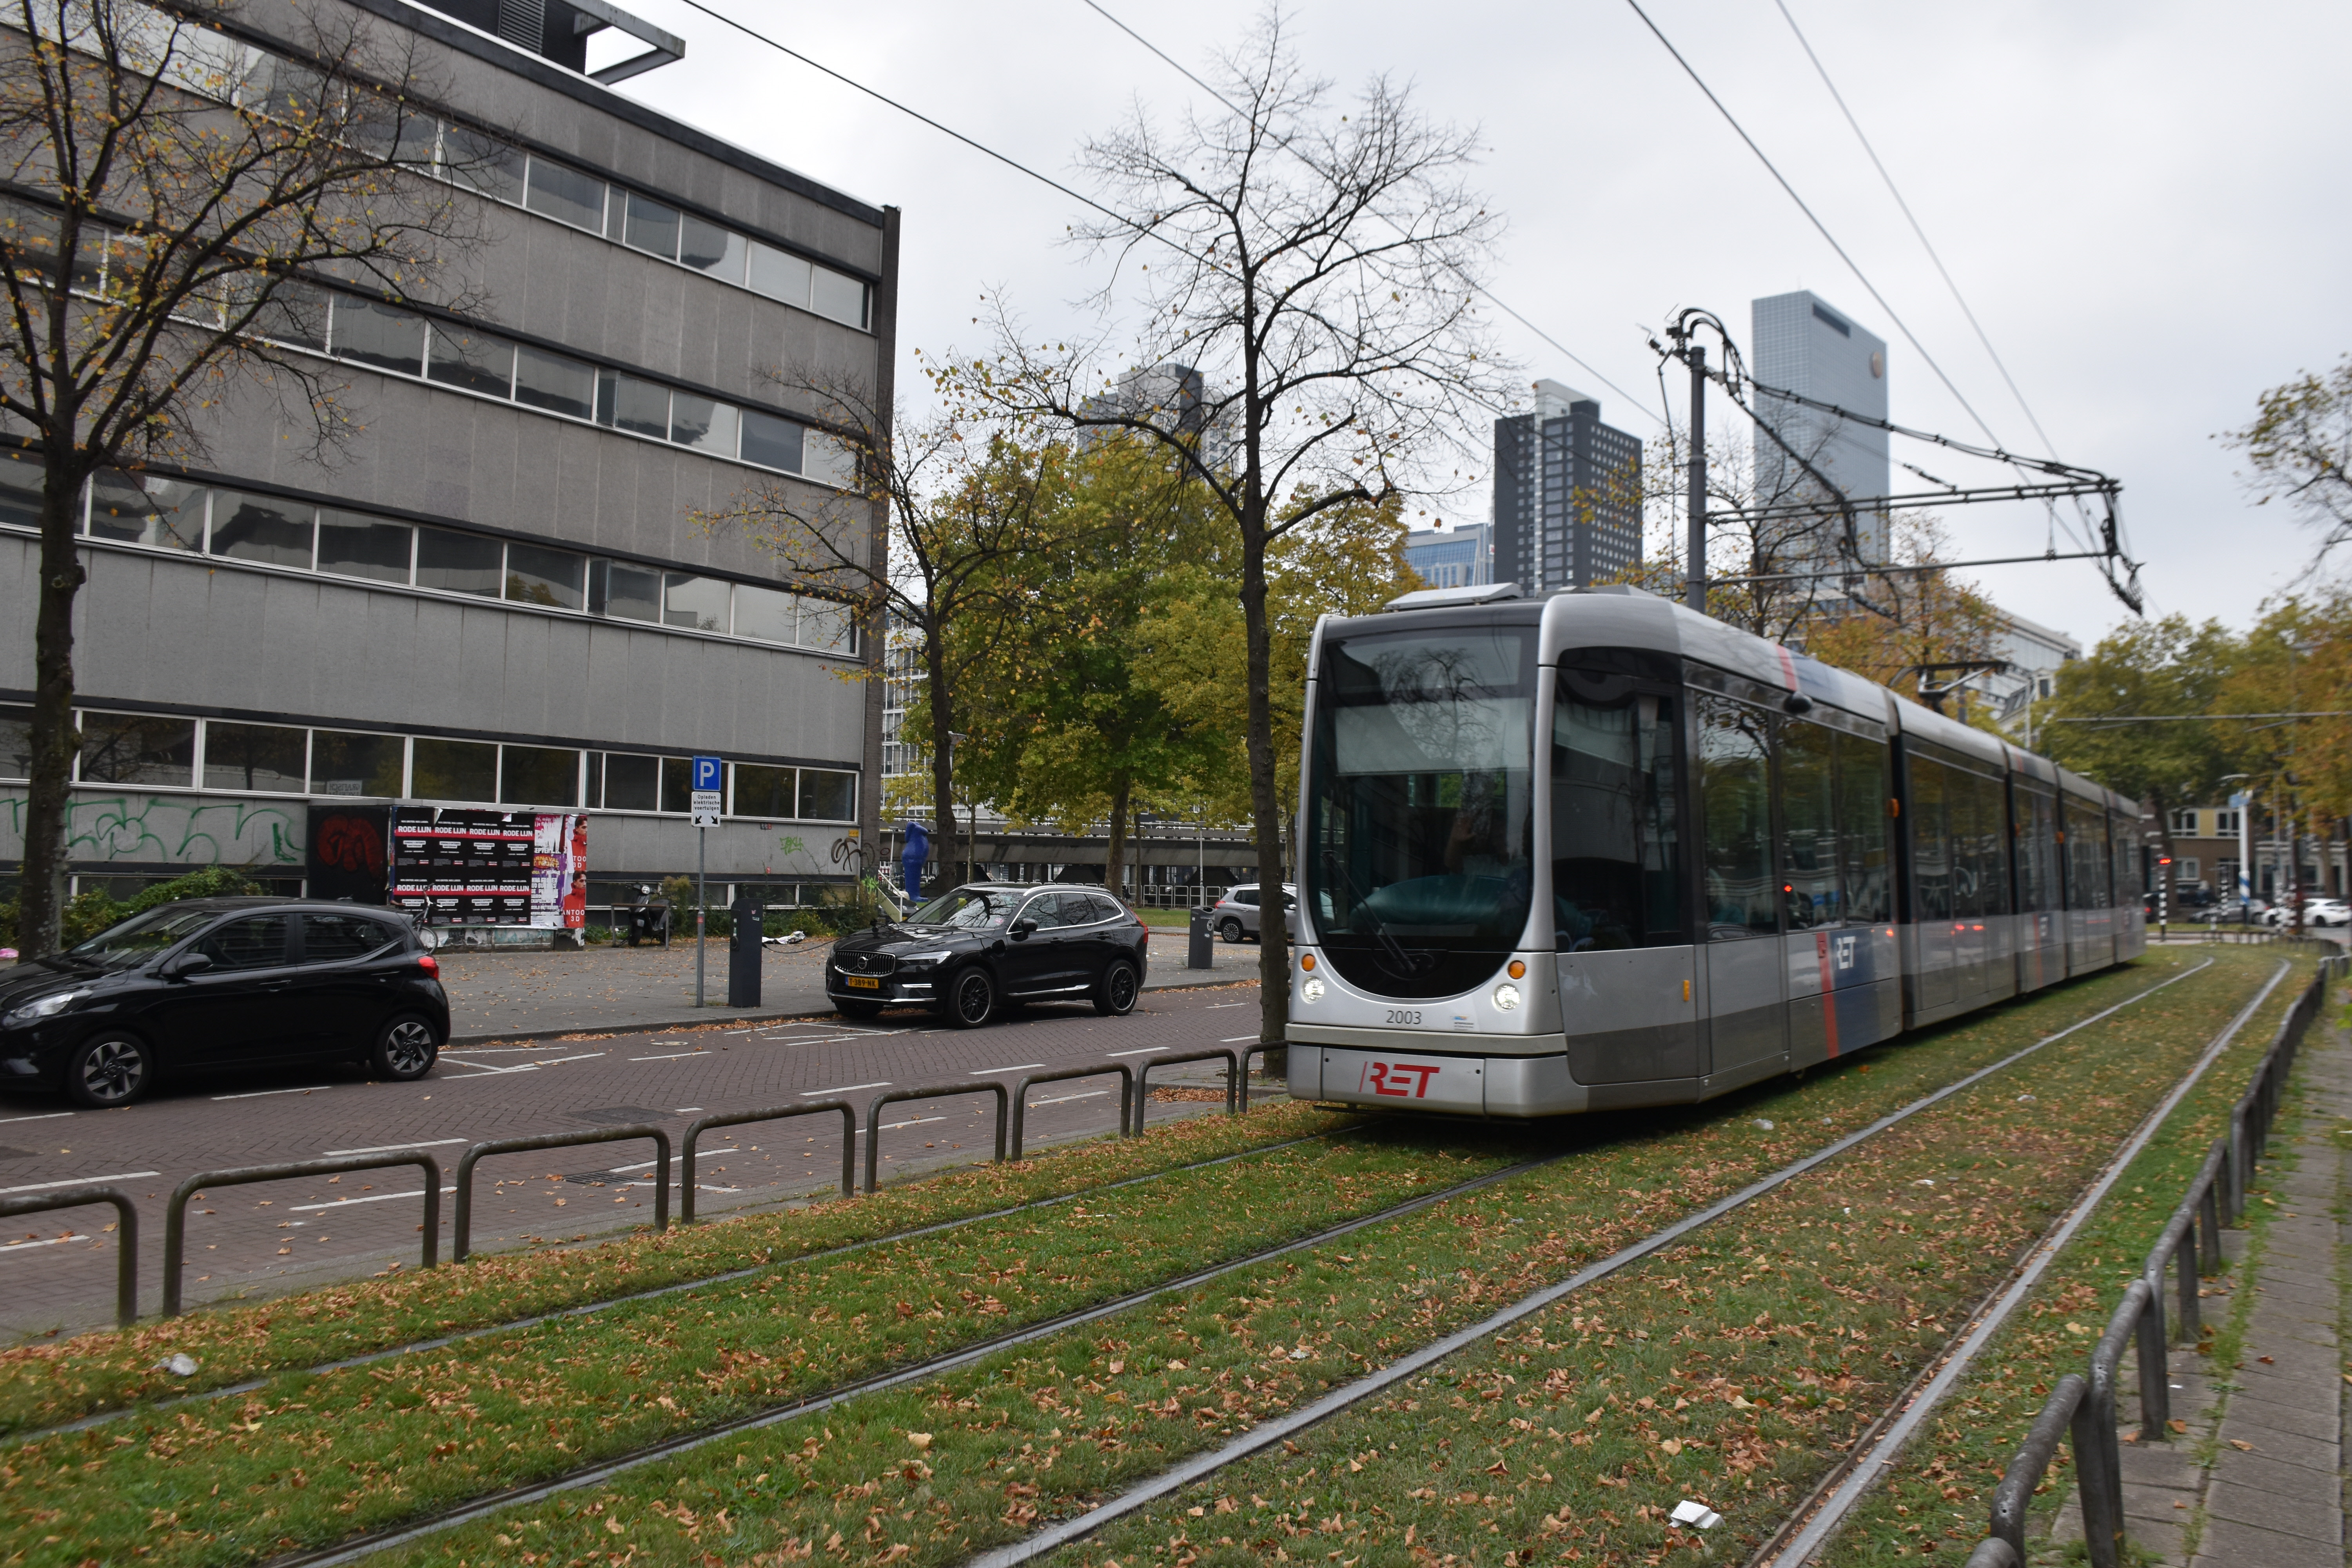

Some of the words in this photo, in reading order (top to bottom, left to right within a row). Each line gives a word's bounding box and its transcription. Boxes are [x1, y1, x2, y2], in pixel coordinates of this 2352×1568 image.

[700, 761, 715, 786] P
[849, 978, 876, 987] T-389-NK
[1386, 1010, 1422, 1024] 2003
[1369, 1062, 1441, 1098] RET
